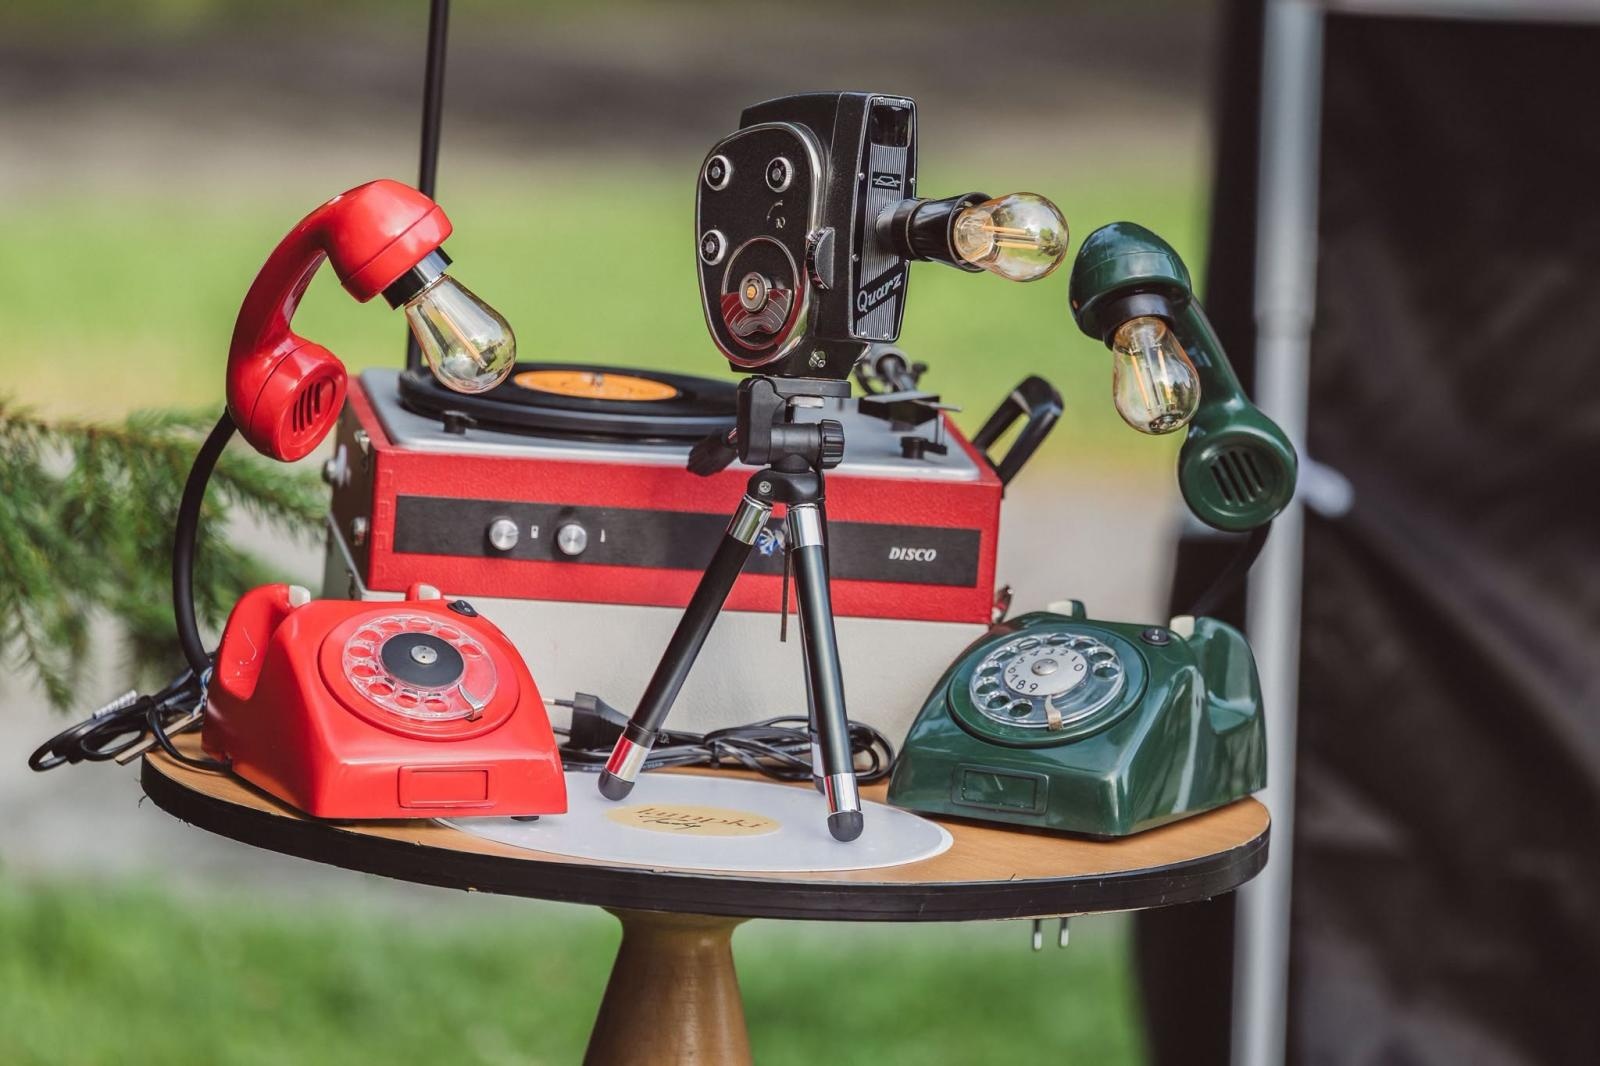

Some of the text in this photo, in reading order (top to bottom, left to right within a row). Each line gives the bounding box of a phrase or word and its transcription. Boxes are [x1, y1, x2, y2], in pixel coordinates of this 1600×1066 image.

[856, 272, 902, 313] Quarz
[888, 546, 937, 561] DISCO
[1016, 679, 1026, 690] 8
[1029, 682, 1039, 693] 9
